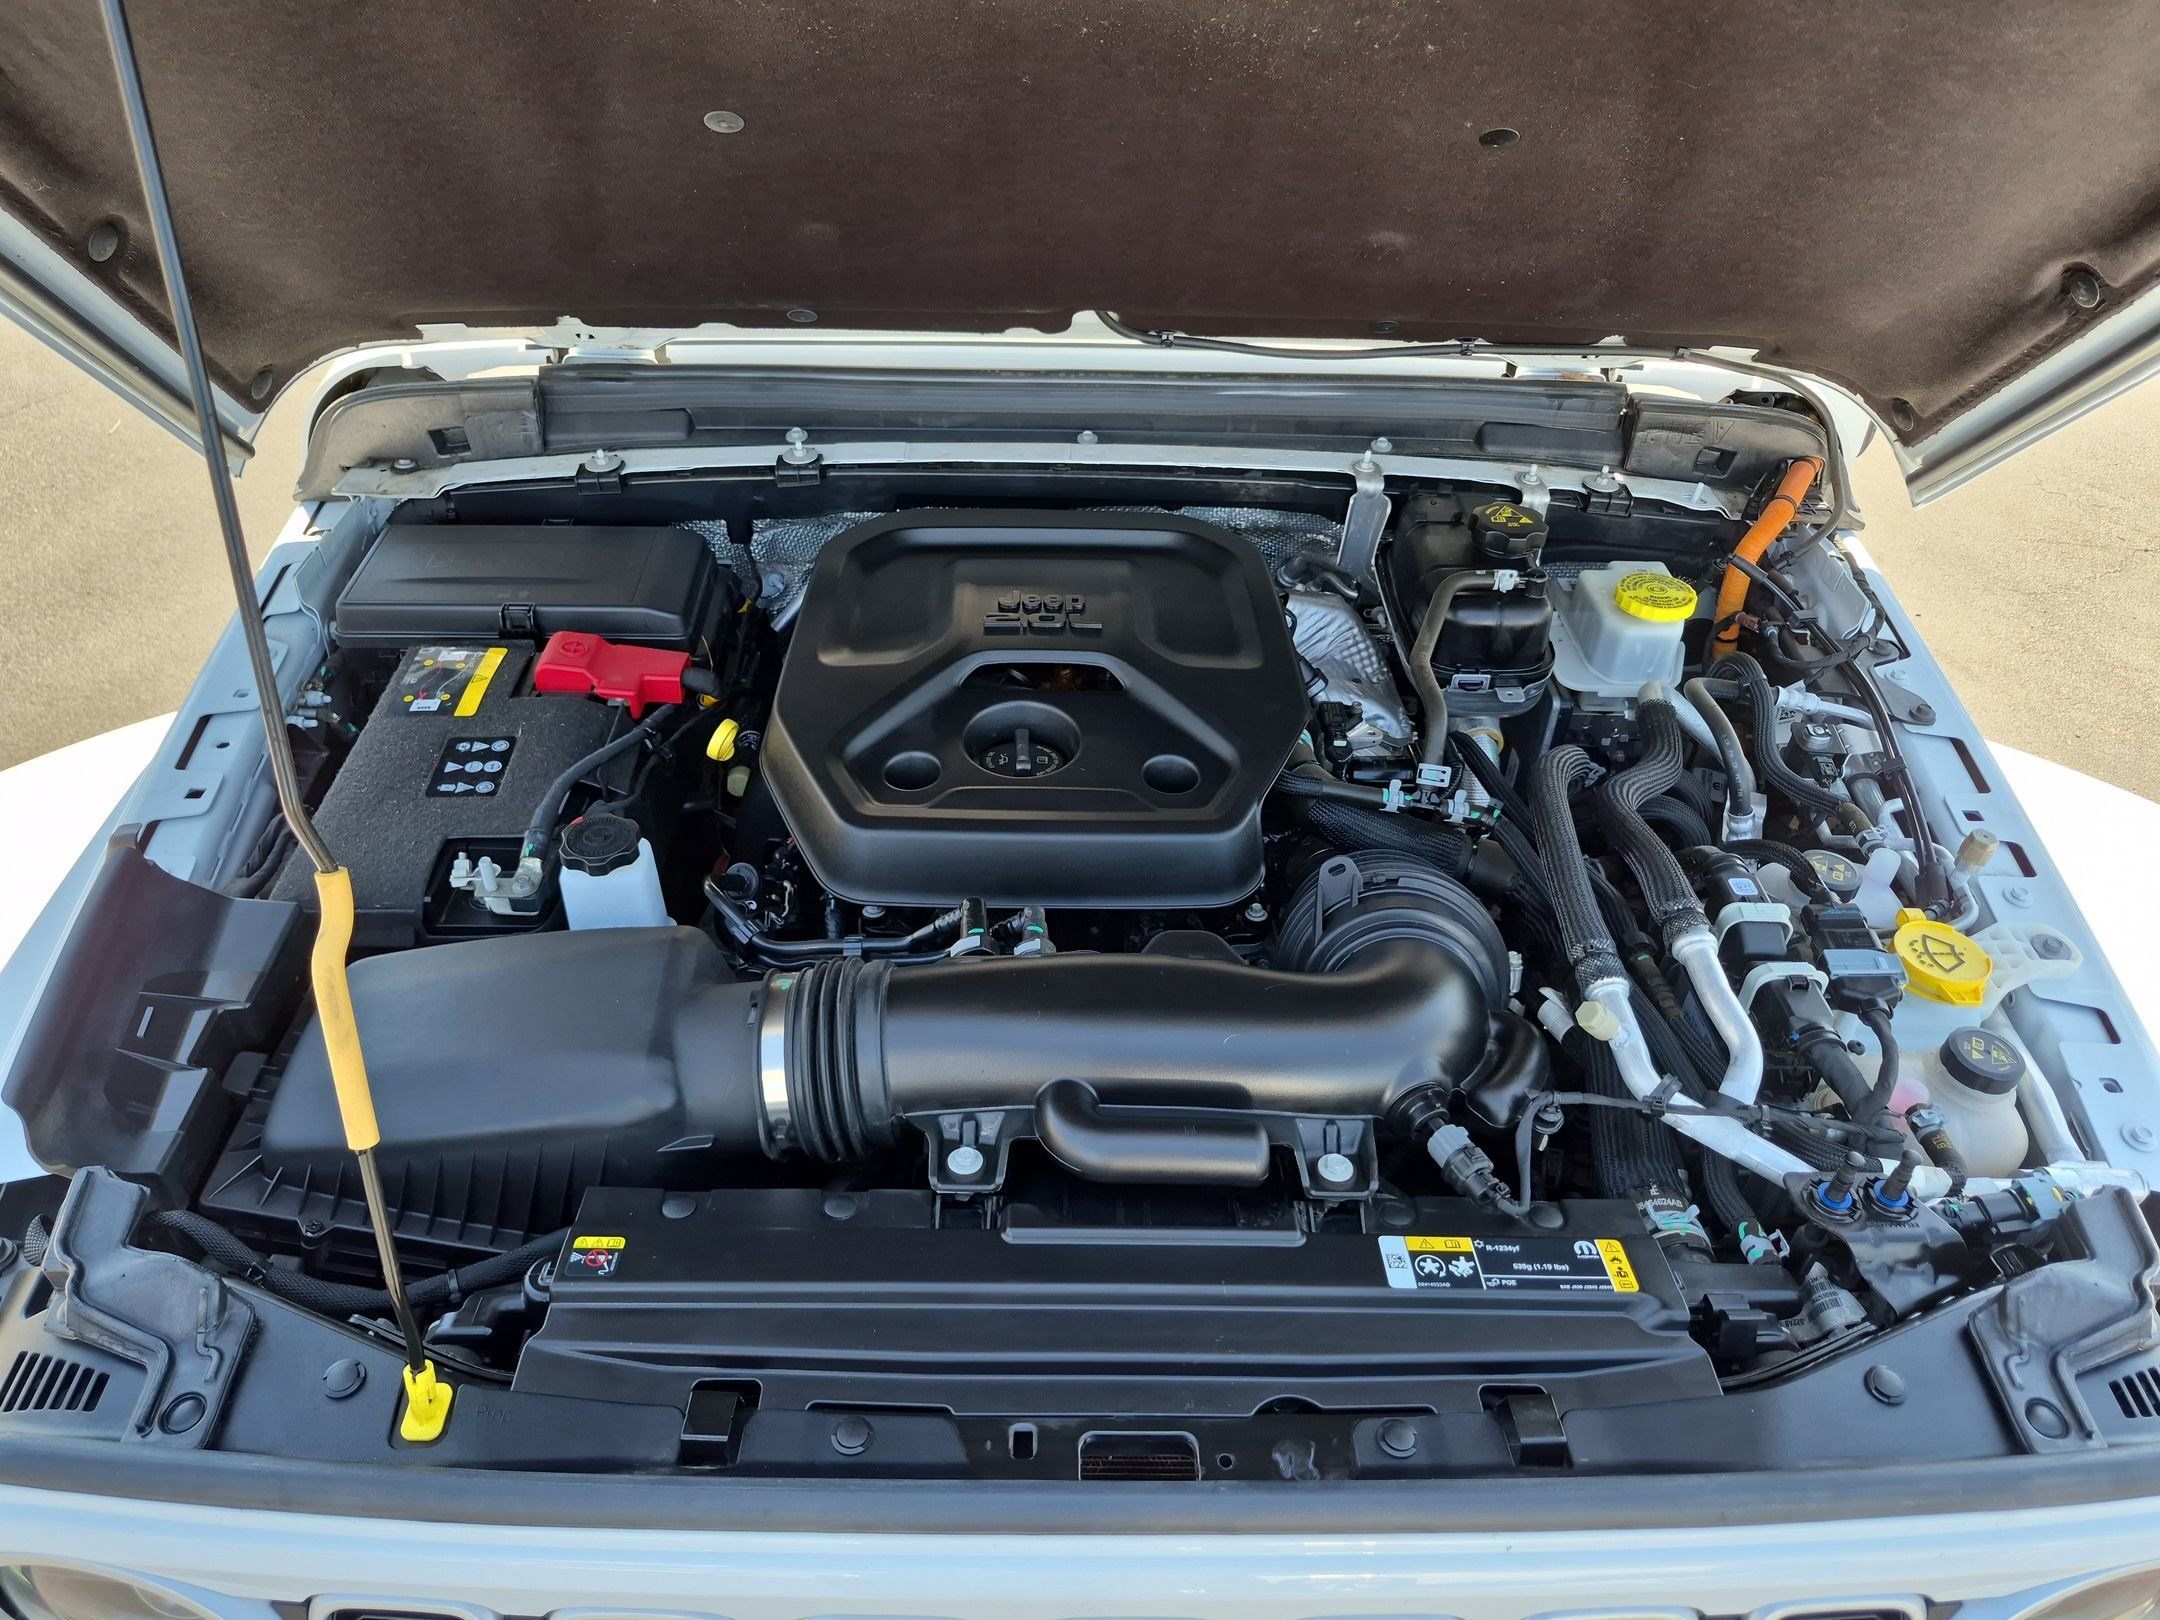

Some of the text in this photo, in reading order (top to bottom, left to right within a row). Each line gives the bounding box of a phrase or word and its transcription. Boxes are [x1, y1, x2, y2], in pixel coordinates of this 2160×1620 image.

[998, 590, 1086, 613] Jeep
[983, 612, 1103, 633] 2.0L
[1486, 1244, 1520, 1253] R-1234yf
